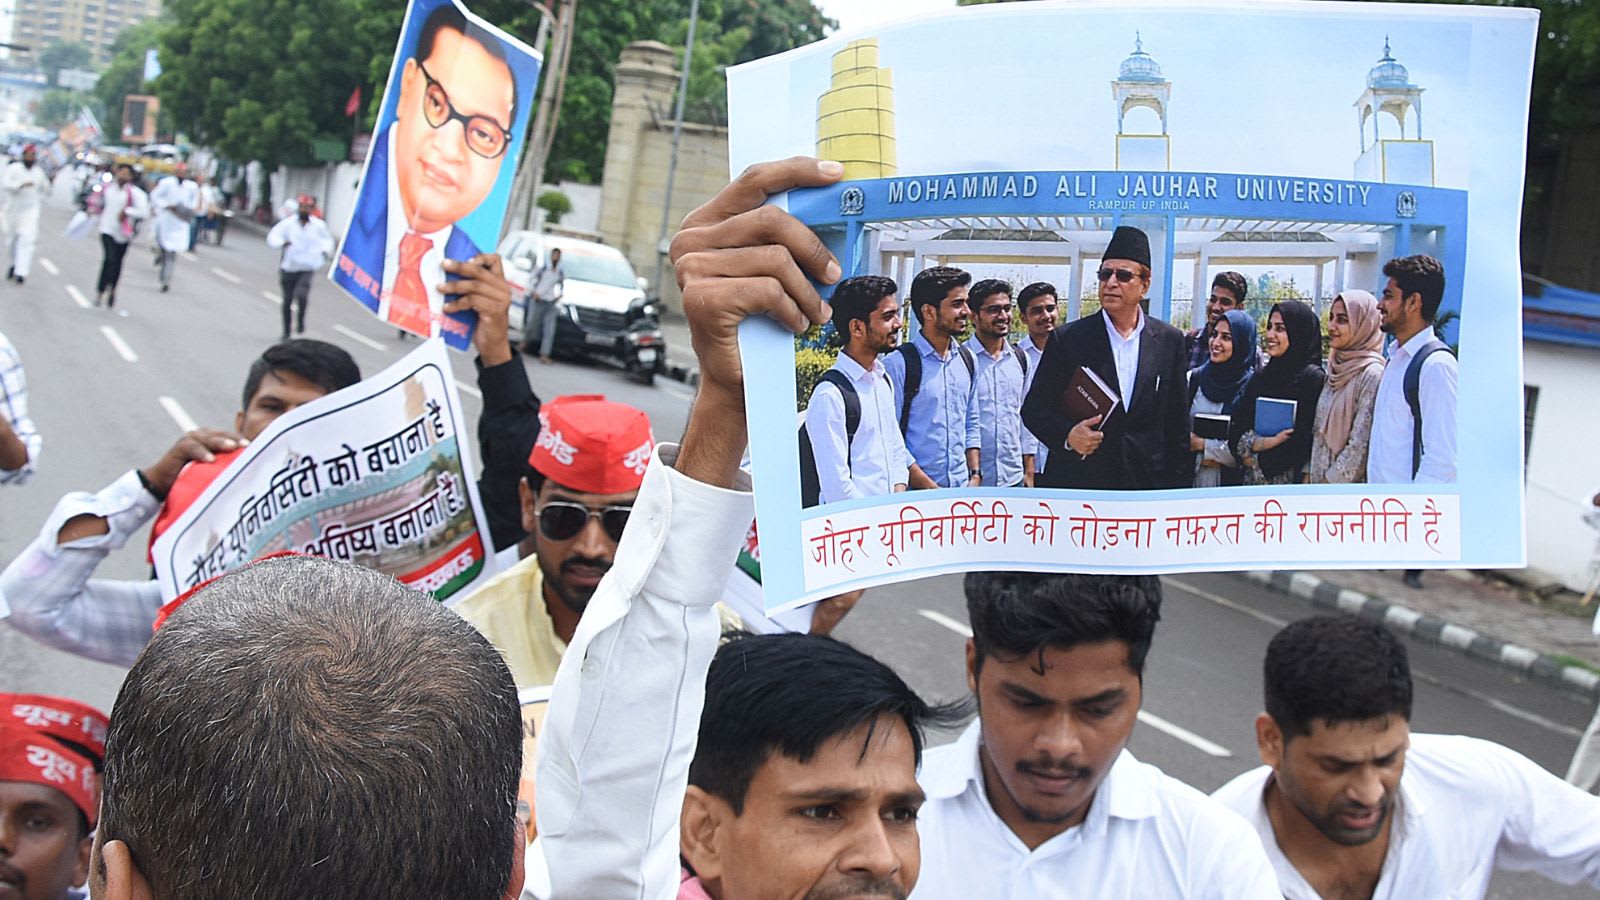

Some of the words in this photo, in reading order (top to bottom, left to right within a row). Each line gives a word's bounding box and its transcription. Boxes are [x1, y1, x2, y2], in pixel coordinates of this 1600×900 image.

[888, 175, 1038, 204] MOHAMMAD
[1055, 175, 1097, 198] ALI
[1117, 175, 1218, 199] JAUHAR
[1236, 178, 1371, 206] UNIVERSITY
[1088, 200, 1136, 210] RAMPUR
[1141, 200, 1155, 210] UP
[1161, 200, 1189, 210] INDIA
[228, 456, 320, 562] यूनिवर्सिटी
[322, 443, 360, 486] को
[362, 417, 429, 472] बचाना
[426, 398, 445, 438] है
[379, 492, 443, 545] बनाना
[810, 519, 870, 573] जौहर
[878, 500, 1013, 567] यूनिवर्सिटी
[1023, 502, 1060, 546] को
[1069, 504, 1156, 550] तोड़ना
[1166, 513, 1245, 546] नफ़रत
[1254, 499, 1288, 544] की
[1297, 498, 1412, 543] राजनीति
[1422, 498, 1442, 554] है
